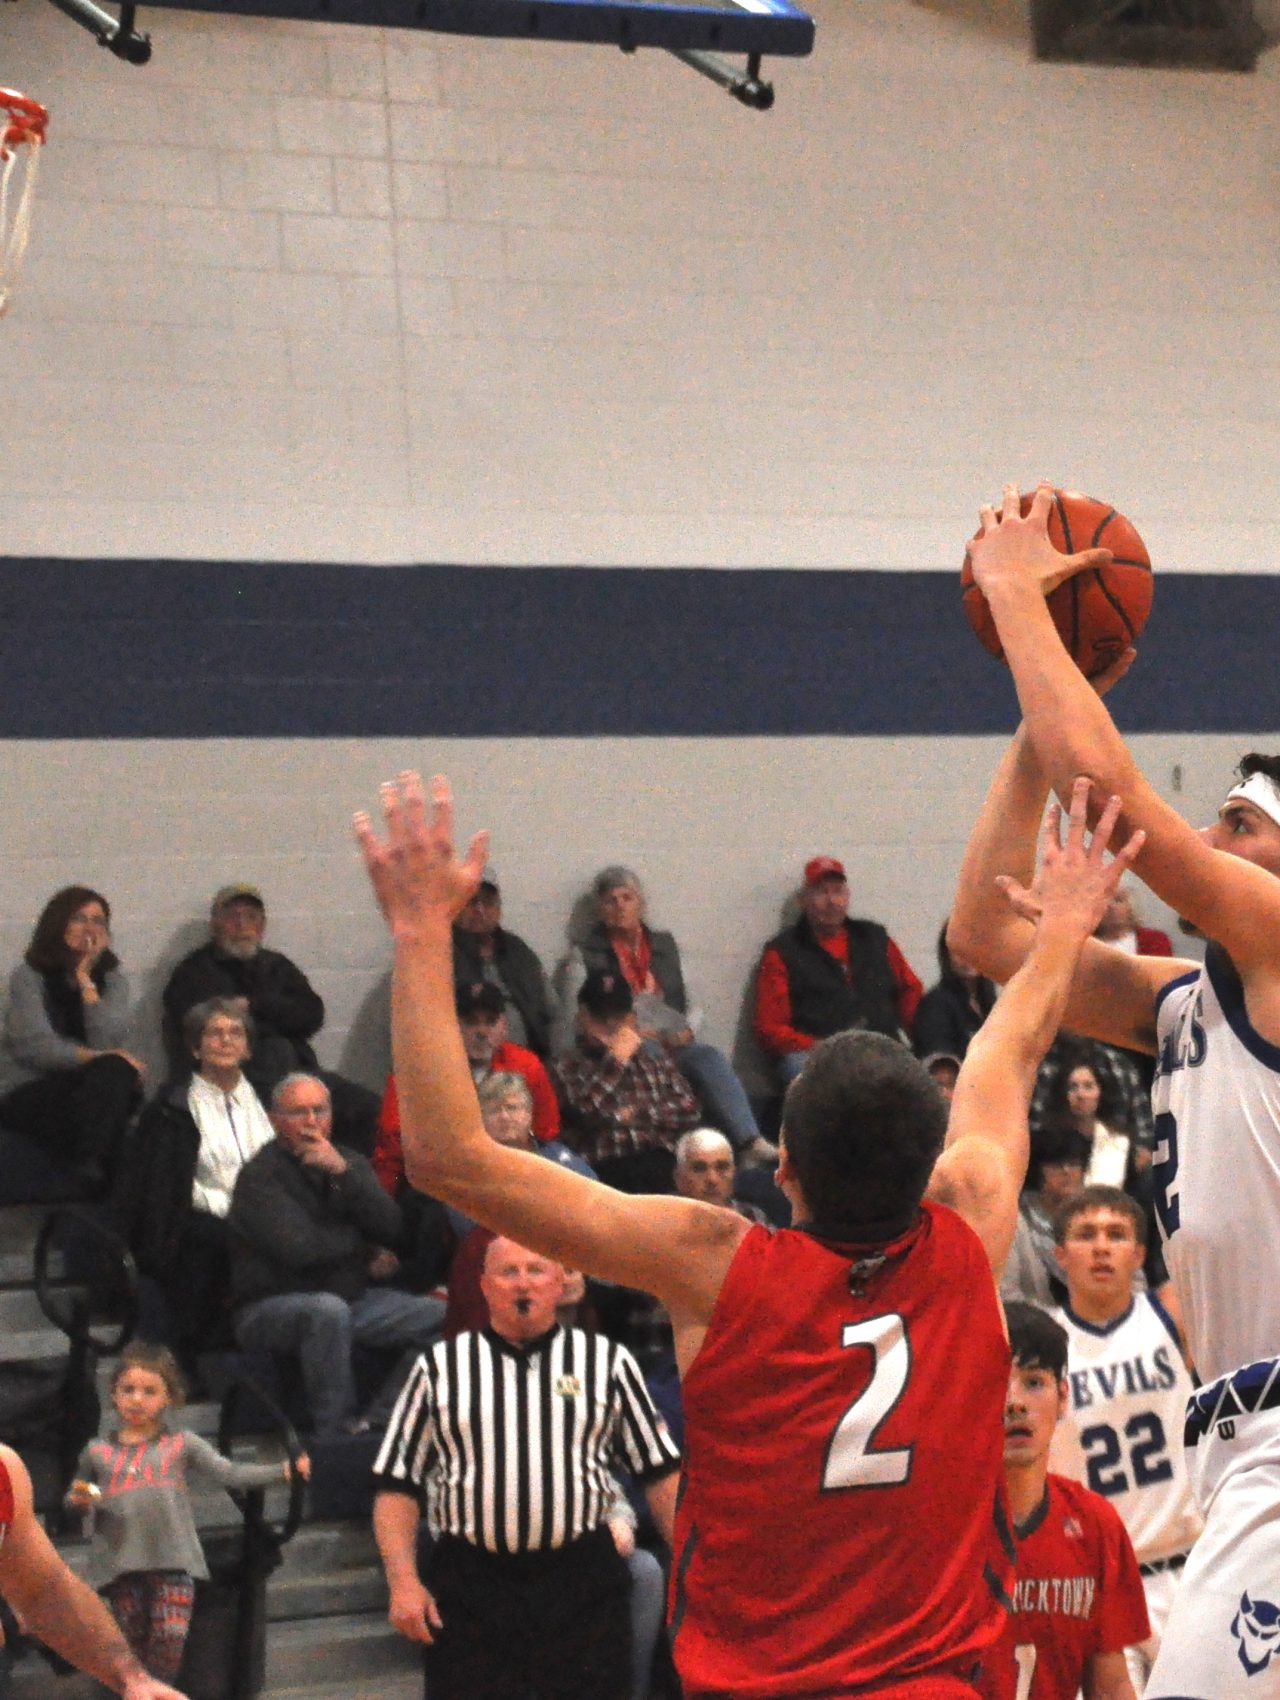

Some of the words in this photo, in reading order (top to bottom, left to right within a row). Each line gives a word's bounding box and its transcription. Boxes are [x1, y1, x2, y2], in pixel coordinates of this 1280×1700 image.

[1156, 987, 1208, 1076] ILS
[820, 1311, 915, 1495] 2
[1070, 1346, 1177, 1409] EVILS
[1080, 1411, 1174, 1496] 22
